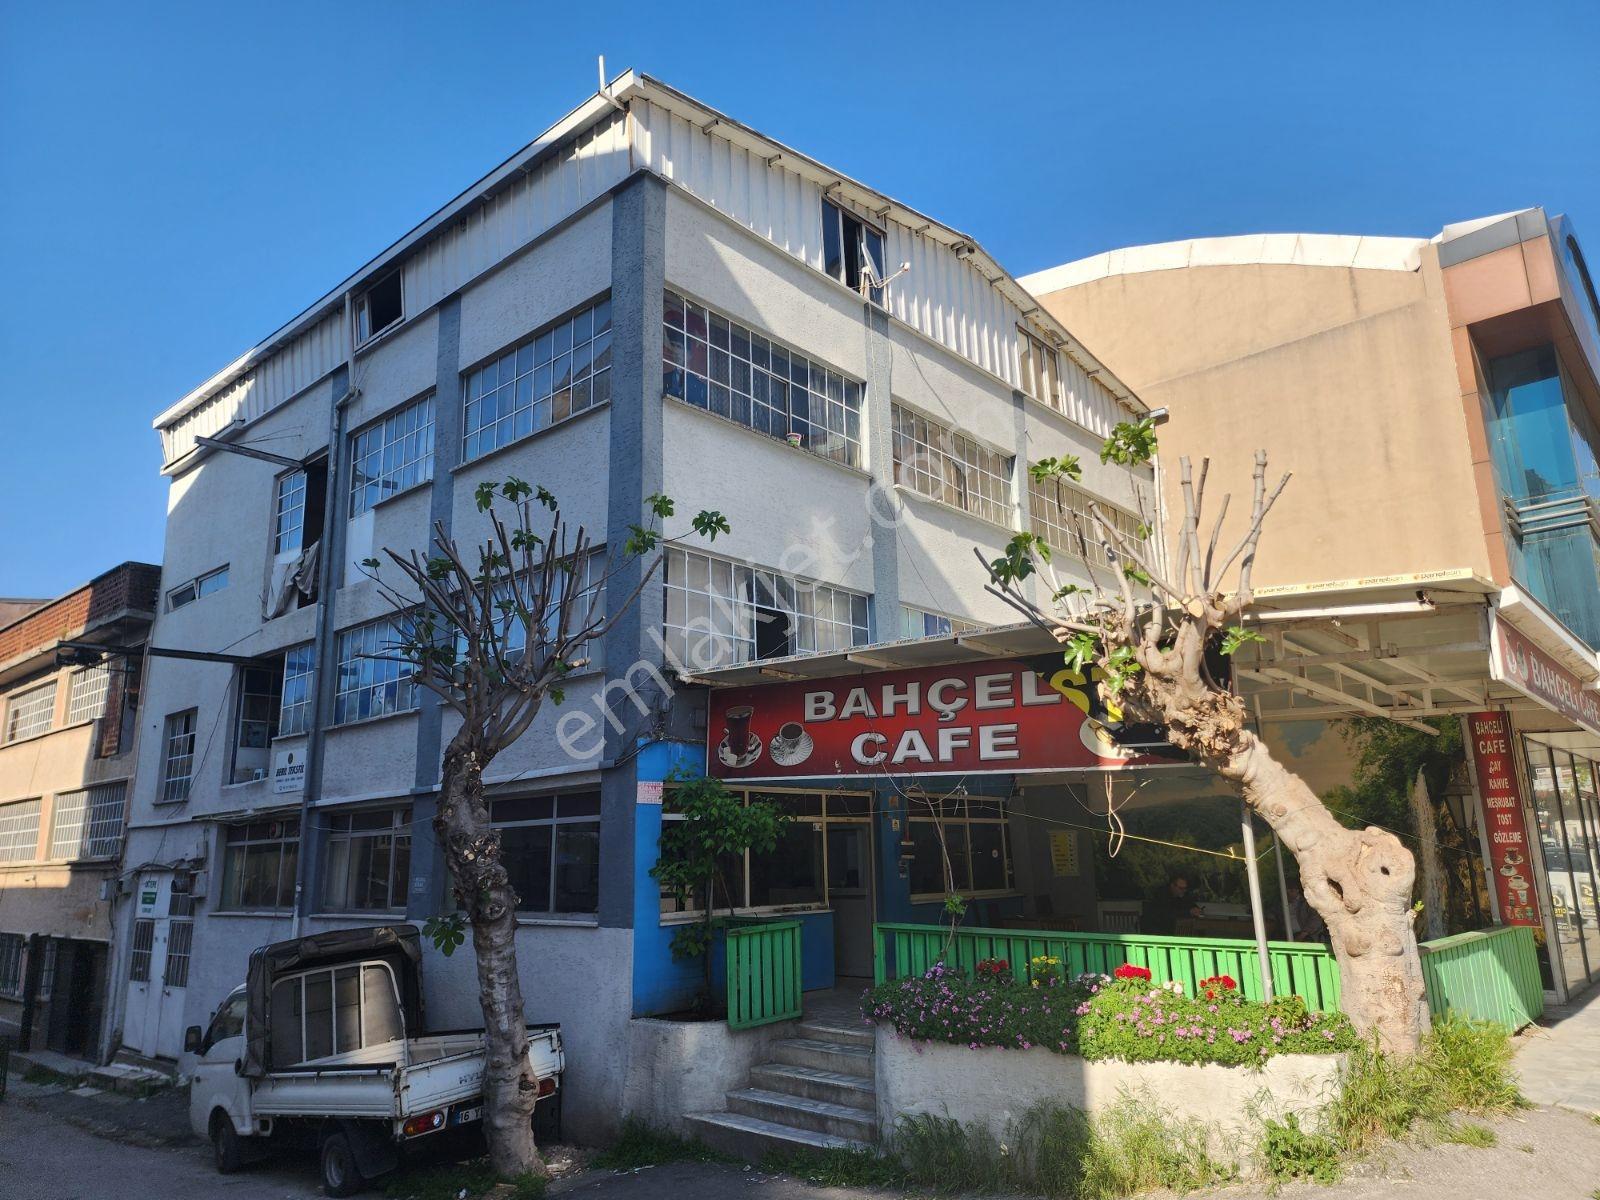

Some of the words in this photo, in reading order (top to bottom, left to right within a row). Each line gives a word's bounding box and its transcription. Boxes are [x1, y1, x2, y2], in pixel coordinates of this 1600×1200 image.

[1475, 718, 1504, 737] BAHÇELİ
[851, 723, 1020, 765] CAFE
[1479, 739, 1507, 754] CAFE
[1489, 760, 1501, 774] ÇAY
[1488, 778, 1510, 790] KAHVE
[1486, 797, 1516, 811] MEŞRUBAT
[1496, 813, 1513, 826] TOST
[1493, 830, 1523, 844] GÖZLEME
[460, 1111, 470, 1122] 16
